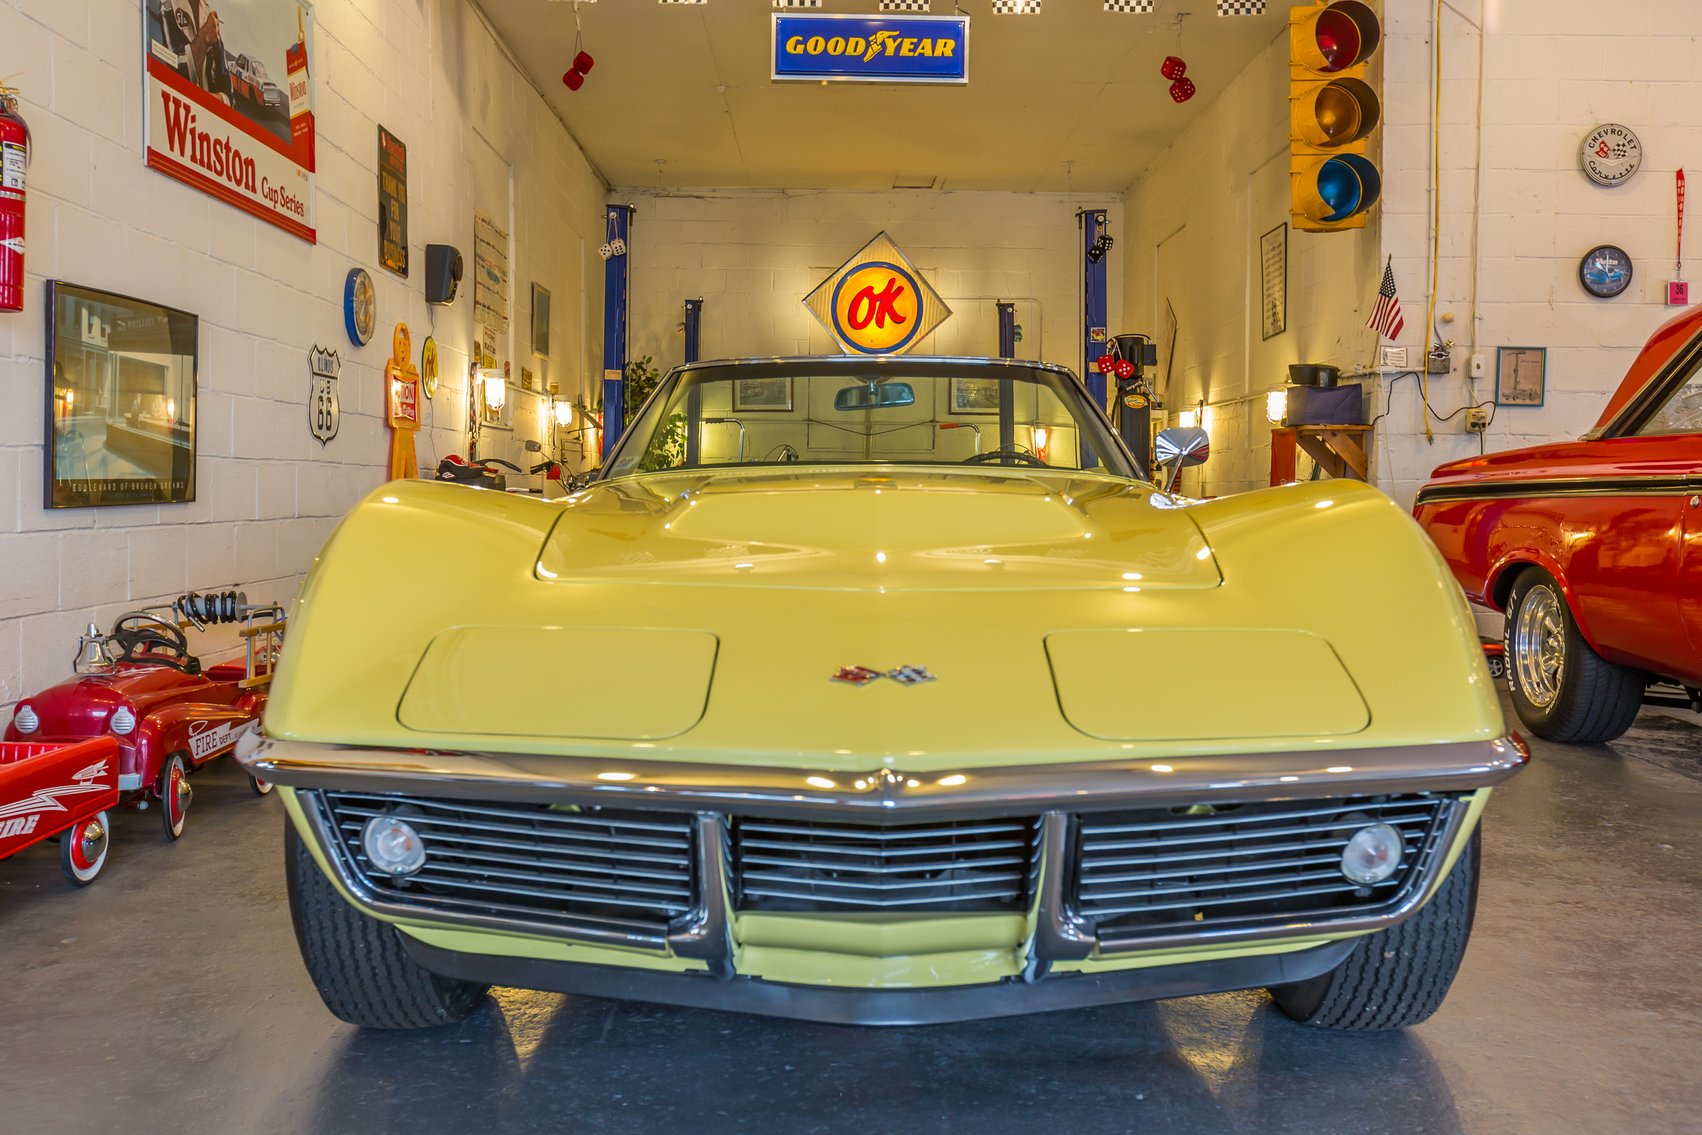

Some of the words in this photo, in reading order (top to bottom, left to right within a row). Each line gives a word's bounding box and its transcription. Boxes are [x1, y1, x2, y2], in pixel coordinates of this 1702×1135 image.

[161, 89, 257, 194] Winston
[261, 176, 279, 209] Cup
[280, 185, 305, 217] Series
[1588, 128, 1637, 151] CHEVROLET
[847, 277, 907, 331] OK
[1675, 284, 1684, 295] 36
[317, 395, 333, 431] 66
[1504, 629, 1516, 692] RADIAL
[195, 731, 218, 756] FIRE
[219, 733, 233, 745] DEPT.
